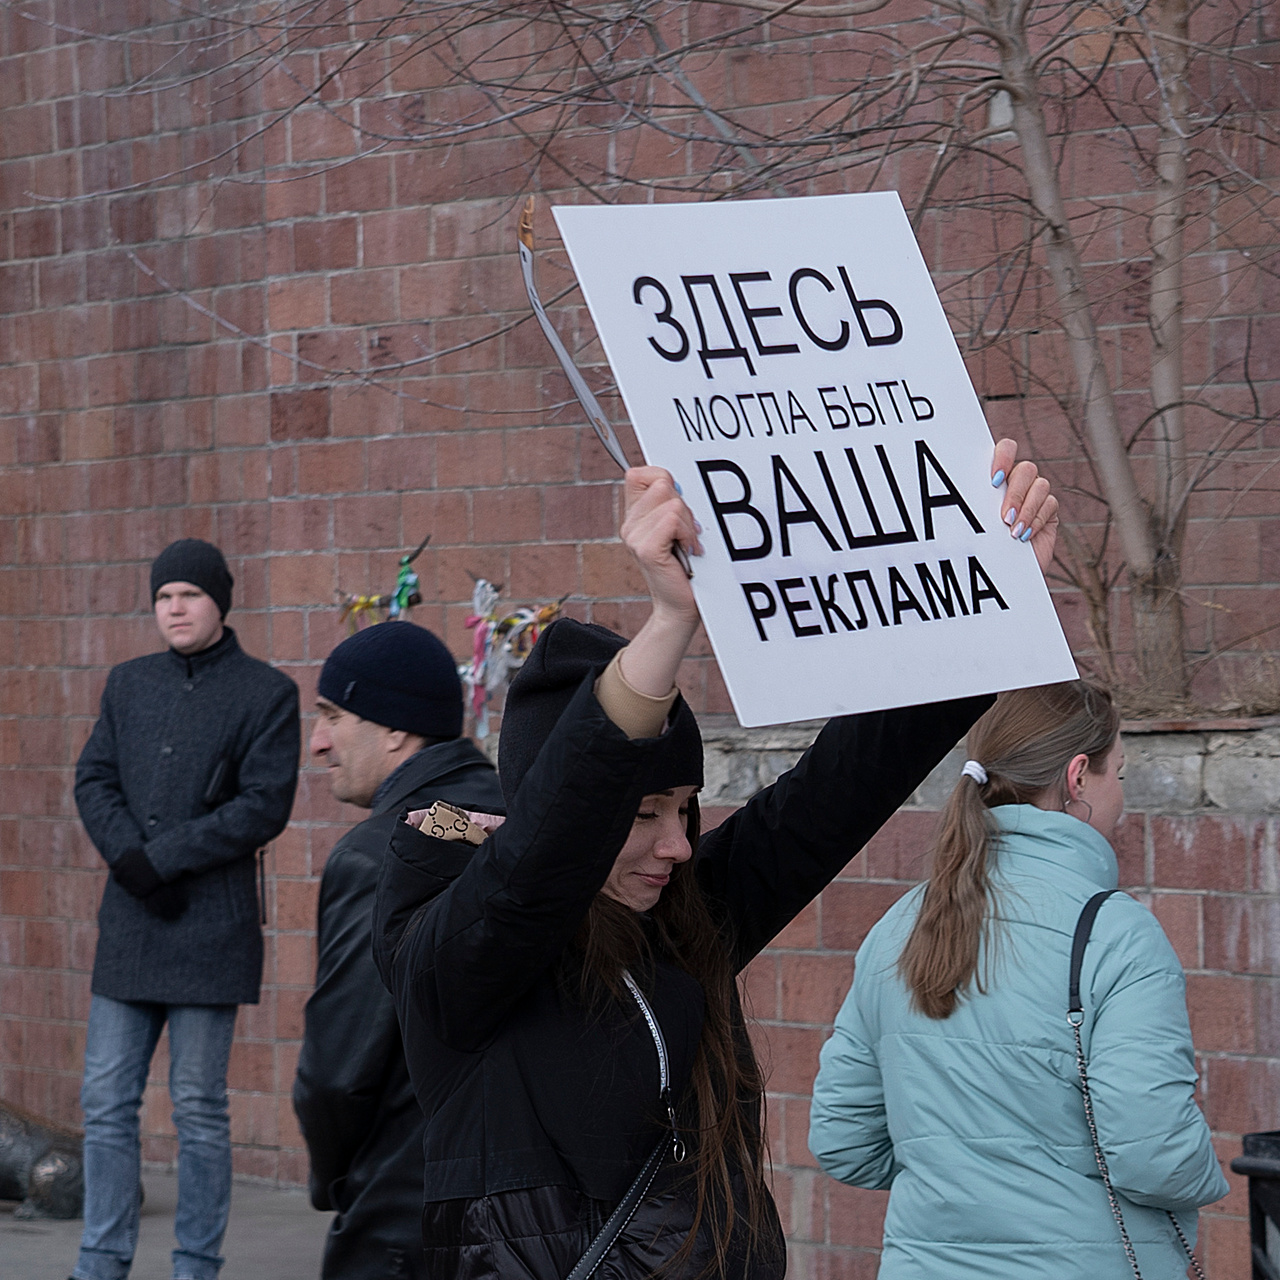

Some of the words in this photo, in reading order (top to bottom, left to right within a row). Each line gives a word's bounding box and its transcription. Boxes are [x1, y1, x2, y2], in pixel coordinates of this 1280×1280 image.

[633, 266, 903, 379] ЗДЕСЬ
[672, 390, 817, 442] МОГЛА
[818, 380, 934, 431] БЫТЬ
[696, 440, 985, 562] ВАША
[741, 556, 1009, 641] РЕКЛАМА
